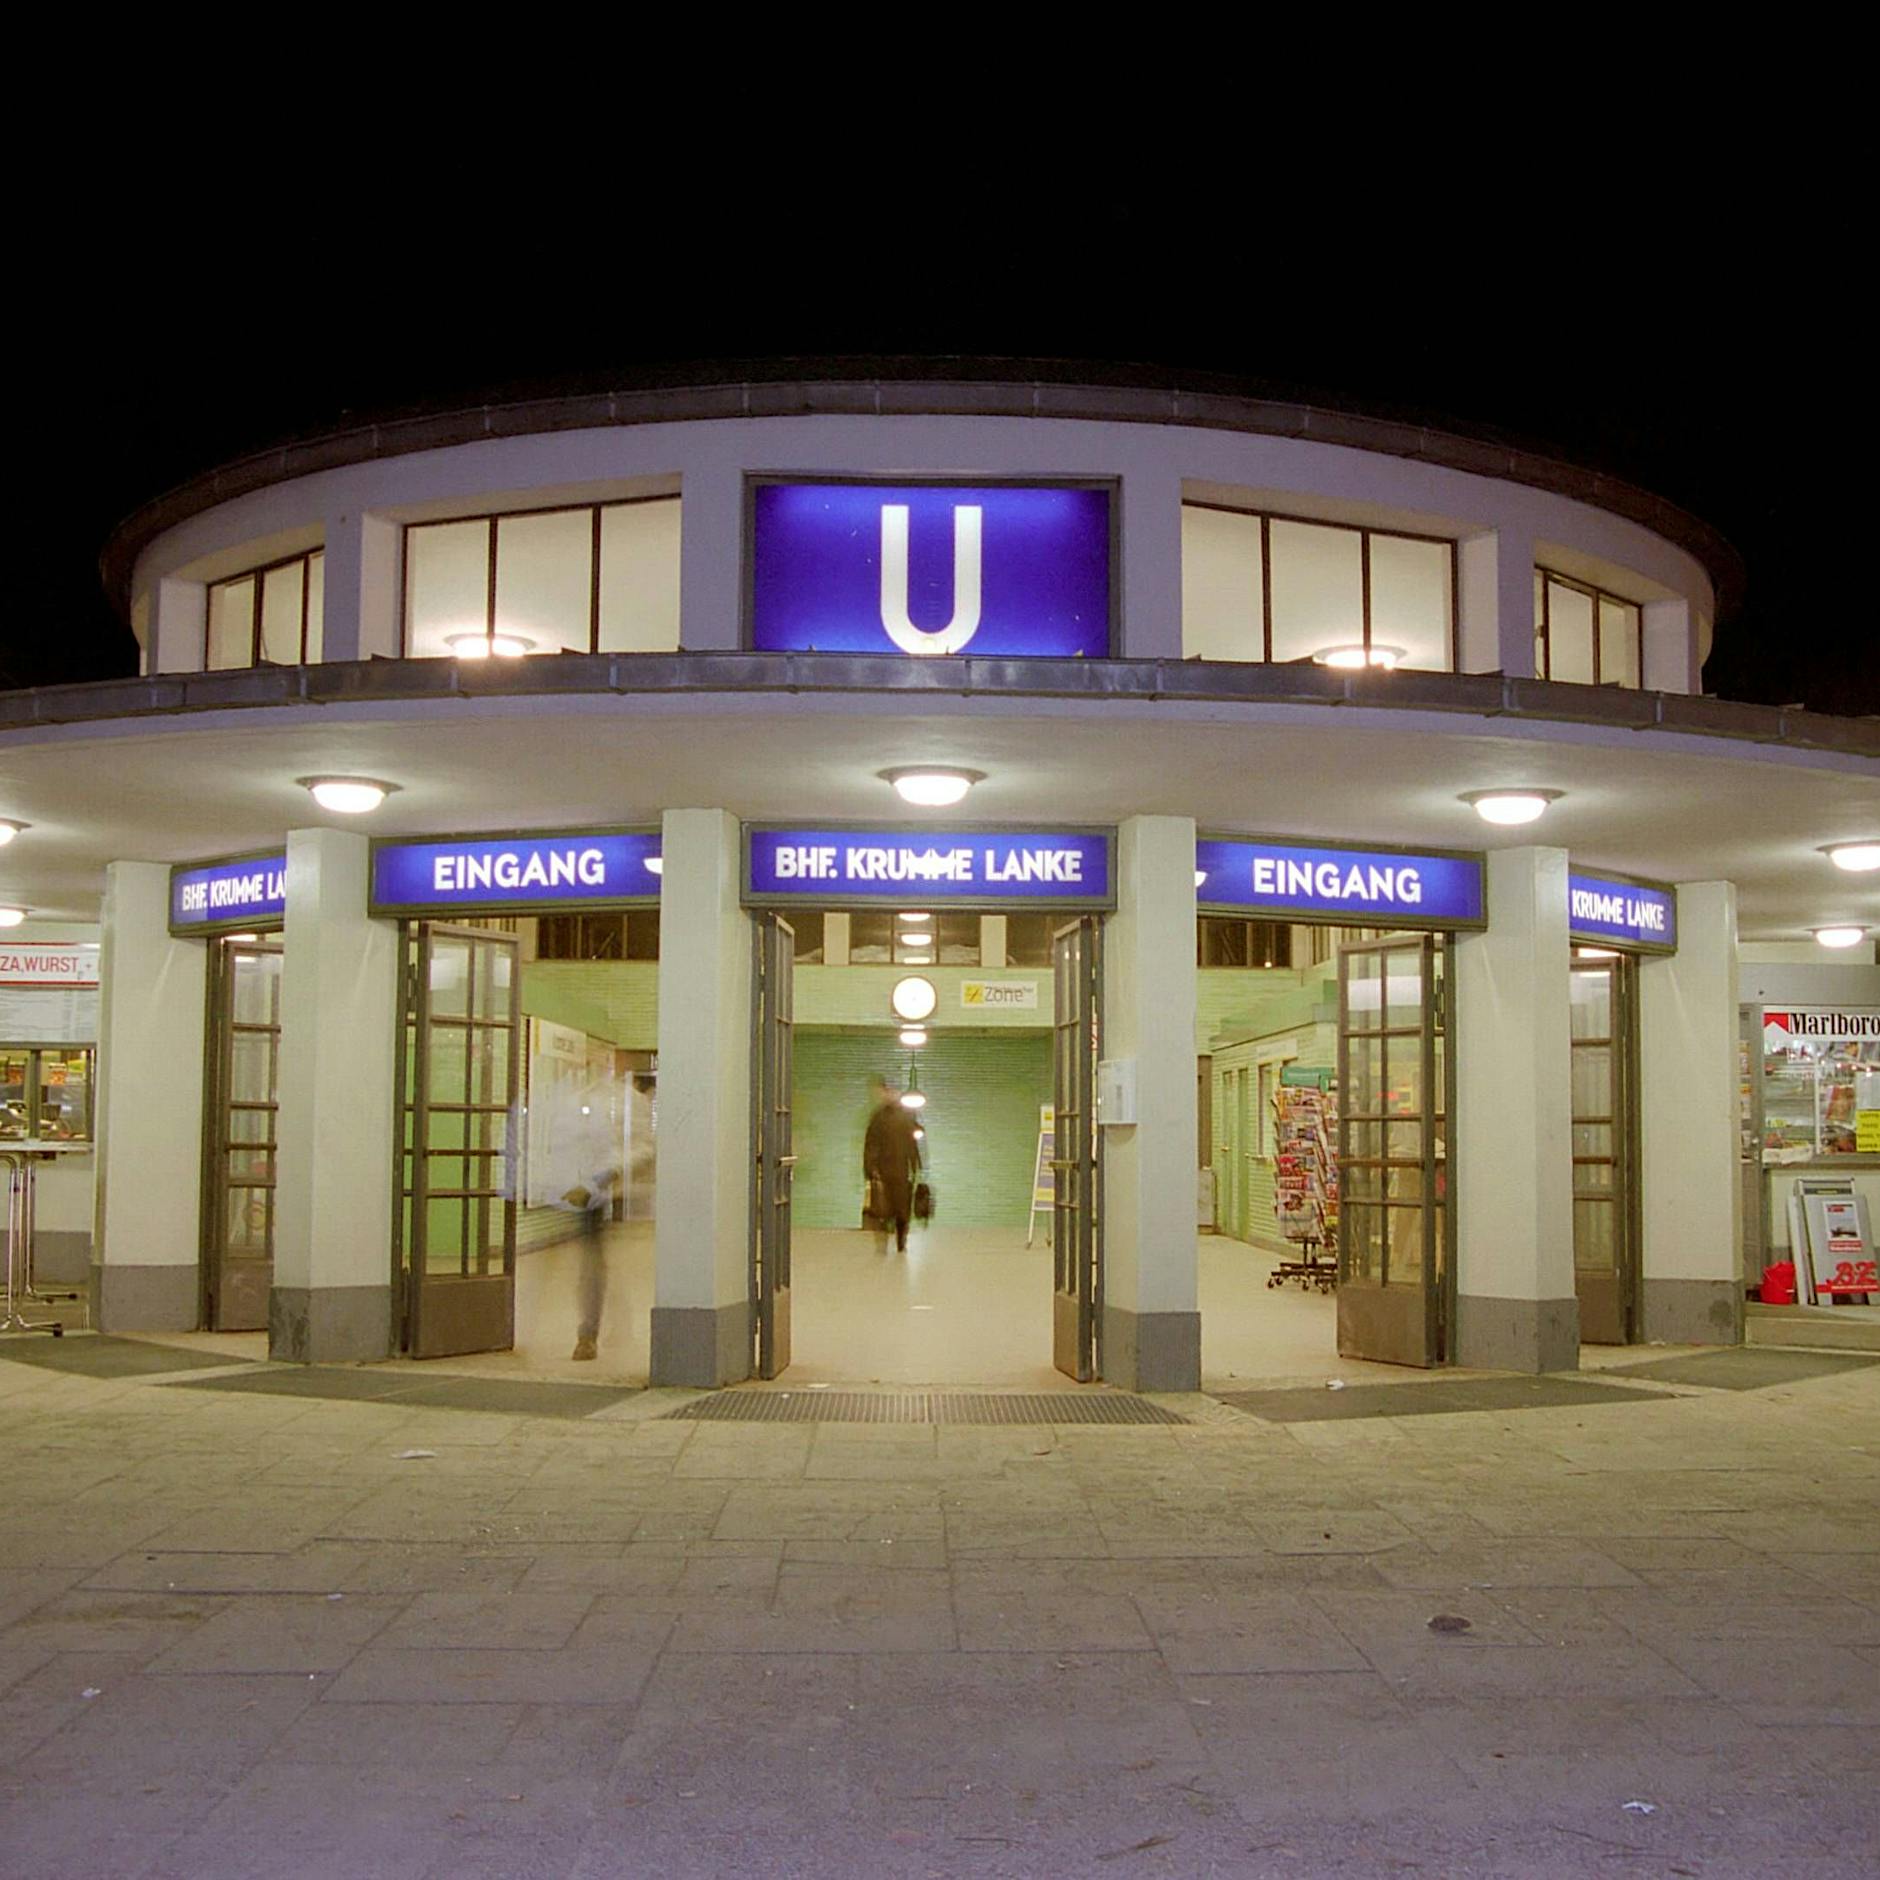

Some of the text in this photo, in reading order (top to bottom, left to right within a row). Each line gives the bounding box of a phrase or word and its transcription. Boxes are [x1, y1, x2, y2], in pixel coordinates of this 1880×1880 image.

[880, 505, 982, 655] U
[434, 849, 605, 890] EINGANG
[774, 847, 838, 879] BHF.
[985, 849, 1083, 882] LANKE
[1253, 858, 1422, 903] EINGANG
[182, 882, 208, 911] BHF.
[209, 874, 264, 908] KRUMME
[1572, 889, 1665, 931] KRUMME LANKE
[984, 985, 1024, 1002] Zone
[1787, 1013, 1880, 1036] Marlboro
